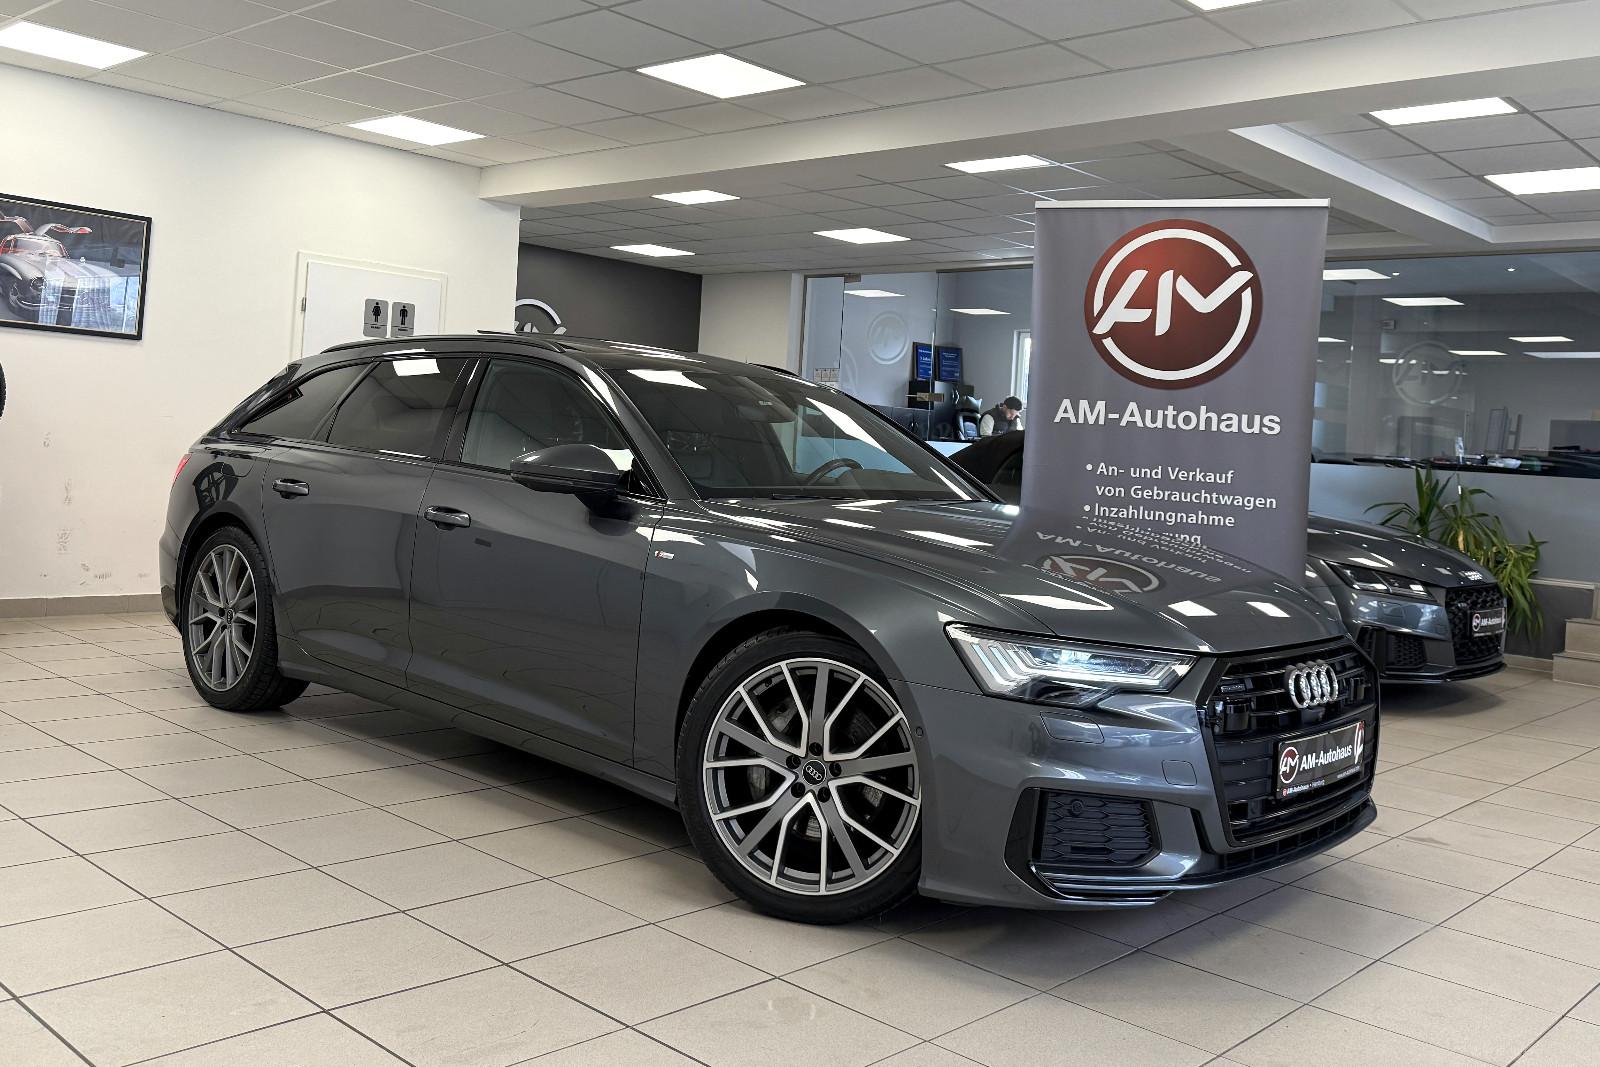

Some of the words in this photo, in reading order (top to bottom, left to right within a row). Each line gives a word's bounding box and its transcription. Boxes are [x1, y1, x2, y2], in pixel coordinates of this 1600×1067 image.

[1053, 398, 1281, 435] AM-Autohaus
[1096, 462, 1125, 476] An-
[1130, 465, 1162, 480] und
[1167, 466, 1235, 484] Verkauf
[1095, 485, 1125, 498] von
[1130, 485, 1277, 510] Gebrauchtwagen
[1094, 502, 1236, 527] Inzahlungnahme
[1300, 744, 1353, 771] AM-Autohaus
